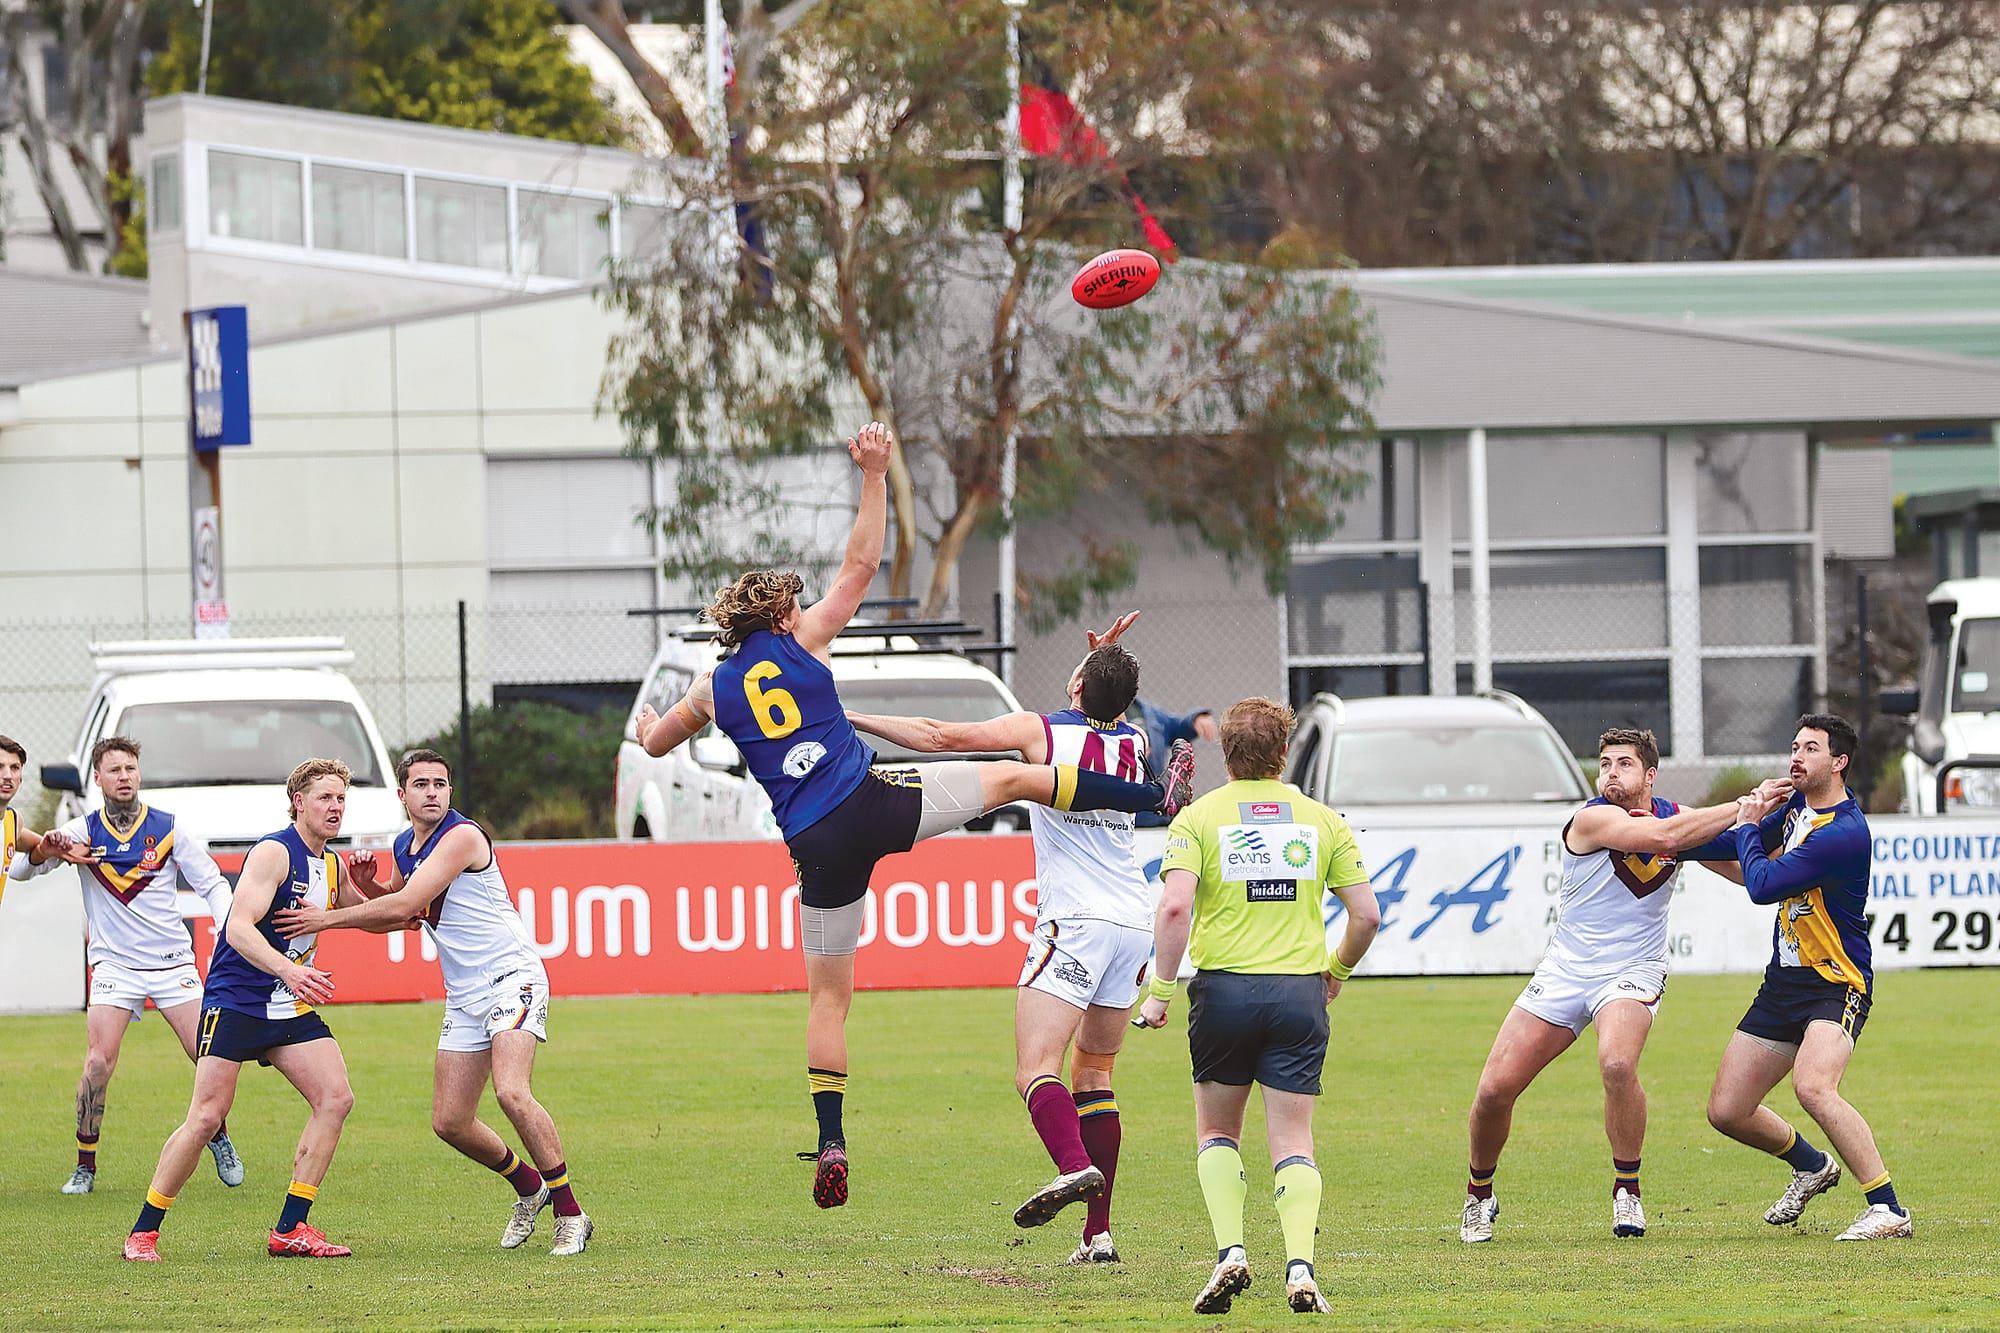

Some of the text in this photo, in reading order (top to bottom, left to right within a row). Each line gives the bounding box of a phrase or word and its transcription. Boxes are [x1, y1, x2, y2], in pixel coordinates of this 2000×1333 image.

[1083, 265, 1147, 298] SHERRIN
[743, 660, 802, 740] 6
[1104, 819, 1129, 831] Toyota
[1300, 829, 1312, 839] bp
[1228, 852, 1271, 865] evans
[1228, 865, 1271, 875] petroleum
[1251, 883, 1295, 896] middle
[1929, 873, 2000, 896] PLAN
[1932, 911, 2000, 951] 29
